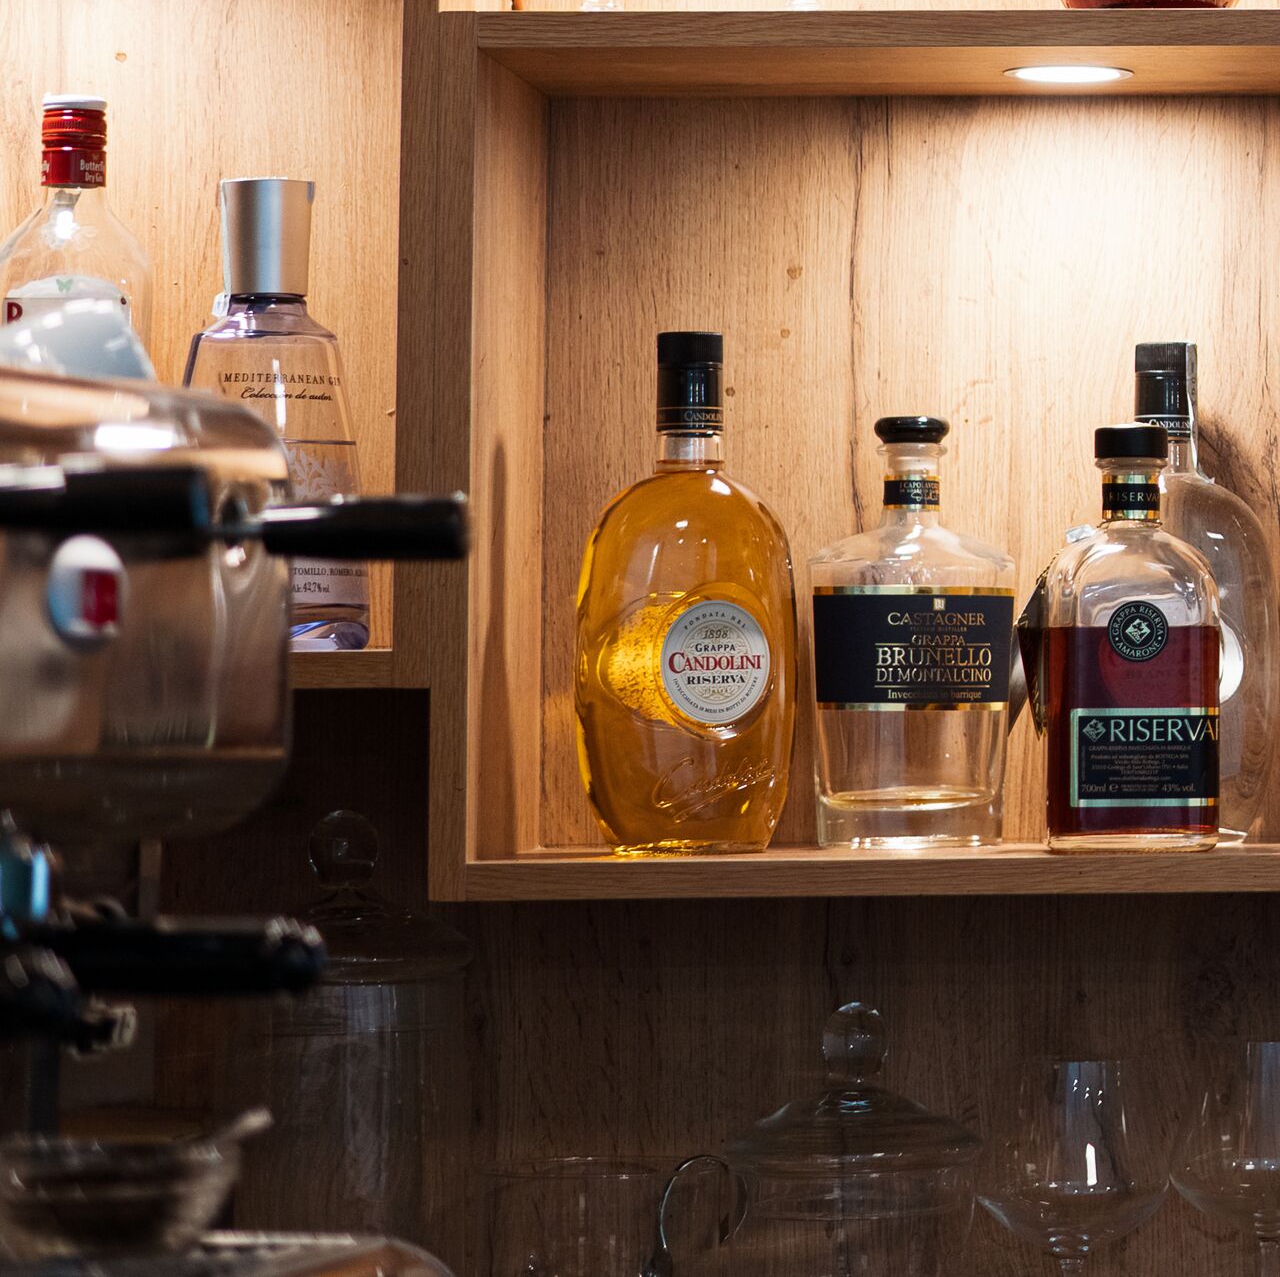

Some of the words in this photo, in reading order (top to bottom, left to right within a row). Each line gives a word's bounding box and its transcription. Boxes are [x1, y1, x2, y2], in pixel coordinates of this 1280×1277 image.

[224, 373, 325, 385] MEDITERRANEAN
[295, 388, 307, 400] de
[684, 611, 726, 630] FONDATA
[731, 615, 746, 628] NEL
[887, 612, 986, 626] CASTAGNER
[1112, 606, 1137, 635] GRAPPA
[1139, 605, 1164, 635] RISERVA
[911, 634, 966, 646] GRAPPA
[695, 643, 736, 653] GRAPPA
[1116, 641, 1161, 657] AMARONE
[668, 652, 762, 674] CANDOLINI
[876, 647, 992, 667] BRUNELLO
[687, 675, 746, 685] RISERVA
[875, 667, 893, 683] DI
[897, 667, 992, 683] MONTALCINO
